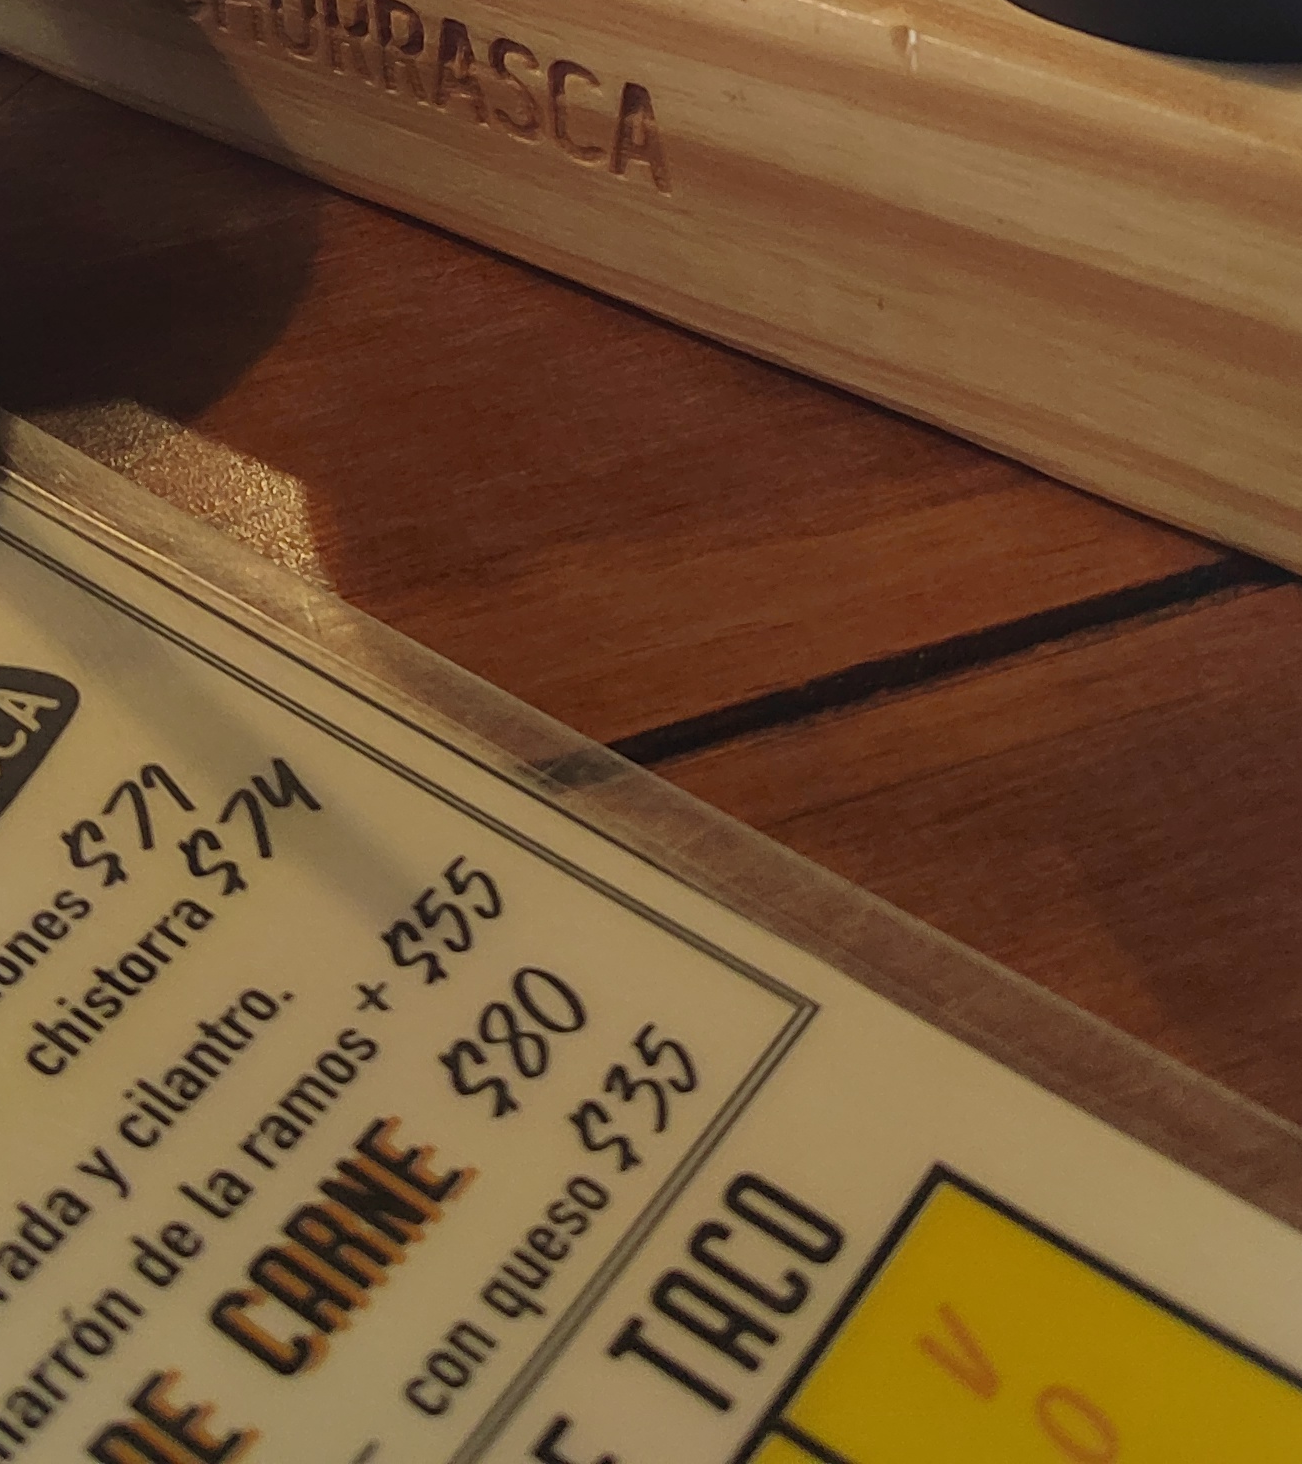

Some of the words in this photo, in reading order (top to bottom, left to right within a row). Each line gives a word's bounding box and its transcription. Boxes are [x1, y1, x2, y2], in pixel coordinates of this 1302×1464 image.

[26, 897, 215, 1077] chistorra
[177, 758, 322, 895] $74
[77, 1146, 131, 1200] y
[118, 987, 295, 1148] cilantro.
[131, 1219, 206, 1289] de
[178, 1168, 256, 1220] la
[241, 1026, 379, 1171] ramos
[380, 855, 502, 984] $55
[206, 1116, 478, 1377] CARNE
[440, 966, 587, 1117] $80
[403, 1320, 498, 1416] con
[481, 1175, 610, 1319] queso
[568, 1023, 699, 1172] $35
[606, 1172, 847, 1412] TACO
